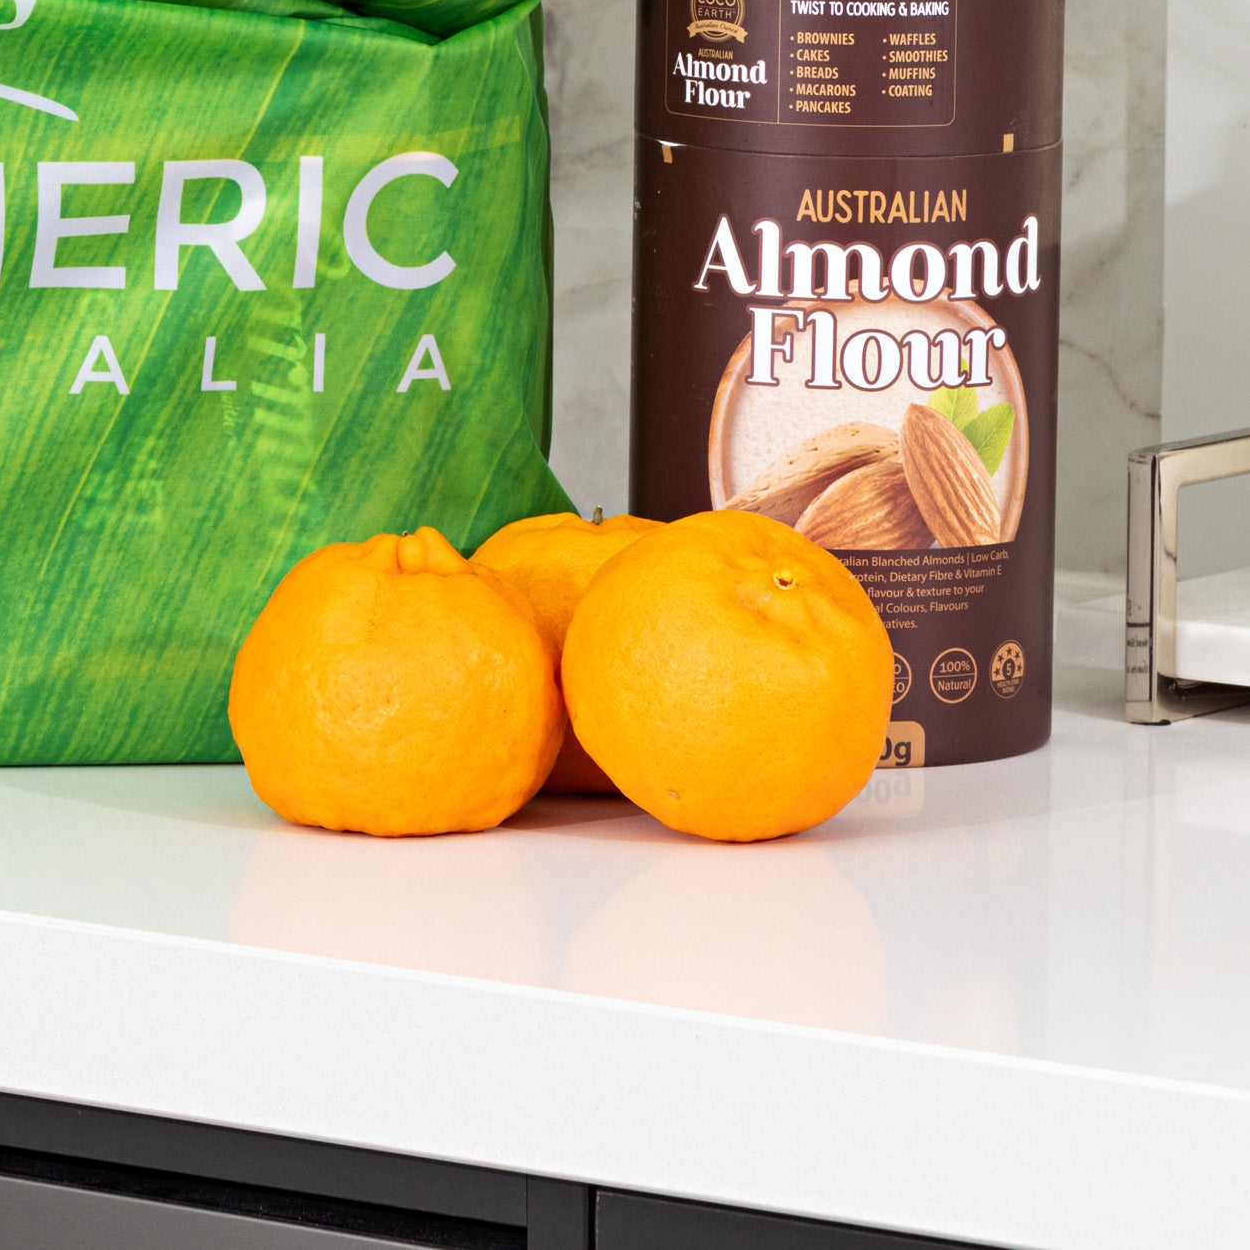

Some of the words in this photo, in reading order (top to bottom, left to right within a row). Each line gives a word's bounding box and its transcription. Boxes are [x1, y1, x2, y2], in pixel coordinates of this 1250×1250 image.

[698, 7, 732, 19] EARTH
[790, 0, 825, 15] TWIST
[829, 1, 843, 16] TO
[846, 2, 895, 16] COOKING
[898, 2, 907, 17] &
[910, 1, 949, 16] BAKING
[797, 32, 855, 46] BROWNIES
[889, 33, 936, 45] WAFFLES
[698, 48, 733, 60] AUSTRALIAN
[796, 49, 830, 62] CAKES
[889, 50, 948, 63] SMOOTHIES
[673, 52, 767, 84] Almond
[796, 66, 839, 79] BREADS
[889, 67, 936, 80] MUFFINS
[684, 79, 751, 109] Flour
[796, 83, 856, 97] MACARONS
[888, 84, 933, 97] COATING
[795, 100, 851, 114] PANCAKES
[796, 188, 967, 224] AUSTRALIAN
[694, 214, 1042, 303] Almond
[746, 306, 1005, 392] Flour
[839, 555, 869, 567] ralian
[871, 555, 920, 567] Blanched
[922, 553, 965, 566] Almonds
[971, 551, 989, 563] Low
[990, 549, 1009, 561] Carb,
[855, 572, 887, 584] otein,
[889, 571, 927, 584] Dietary
[929, 569, 953, 581] Fibre
[955, 569, 962, 580] &
[963, 567, 996, 579] Vitamin
[997, 565, 1002, 576] E
[867, 587, 903, 599] flavour
[906, 586, 914, 598] &
[916, 587, 951, 598] texture
[953, 586, 964, 596] to
[965, 584, 985, 597] your
[886, 603, 928, 614] Colours,
[929, 602, 969, 612] Flavours
[939, 660, 971, 673] 100%
[937, 679, 972, 691] Natural
